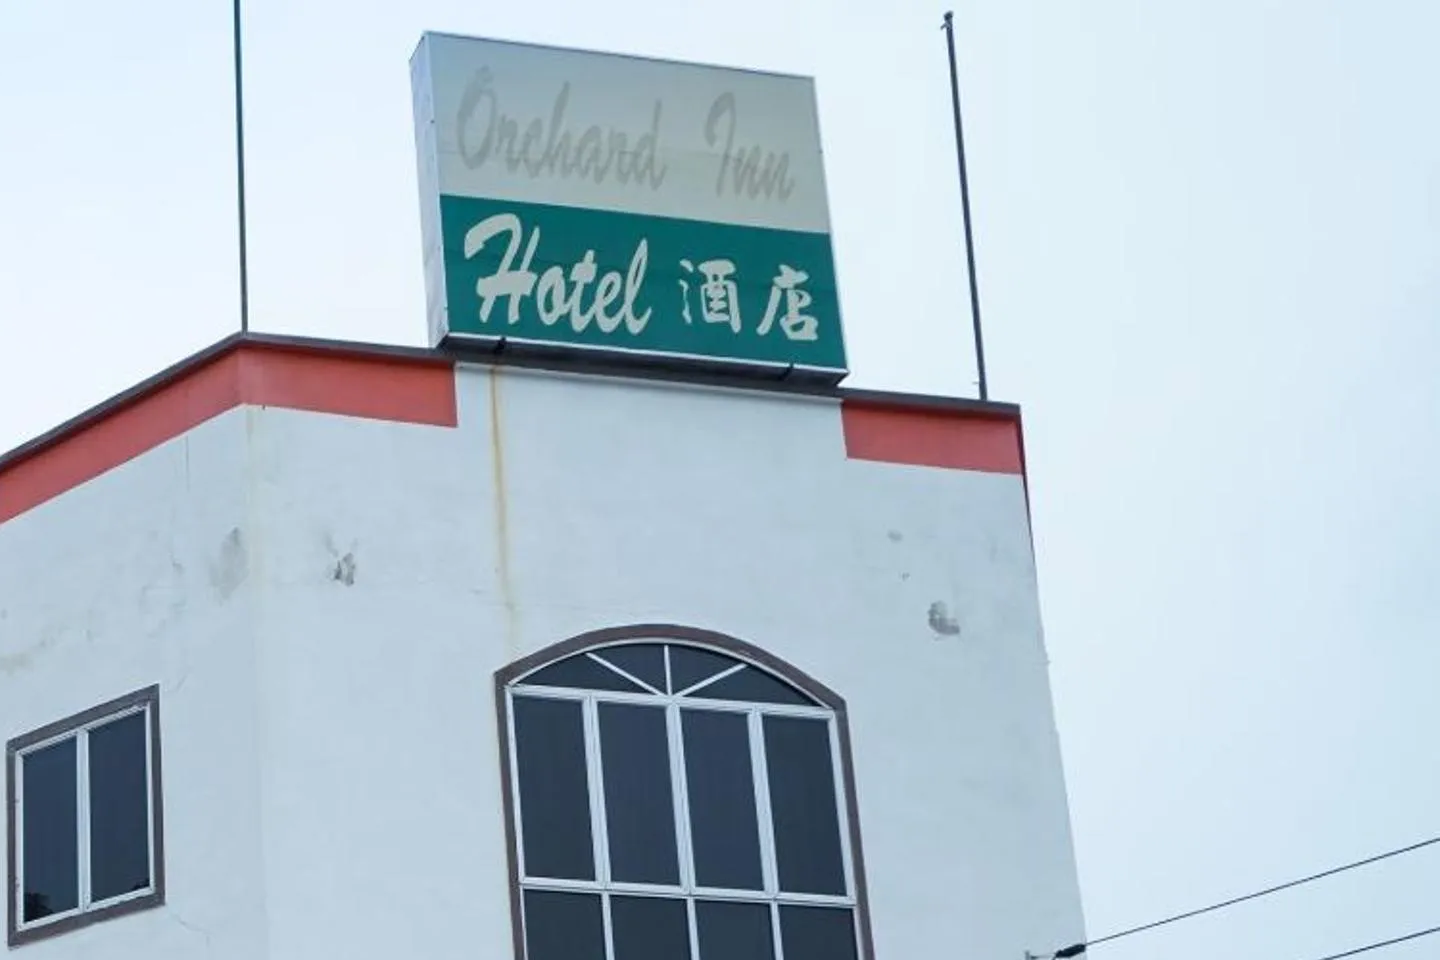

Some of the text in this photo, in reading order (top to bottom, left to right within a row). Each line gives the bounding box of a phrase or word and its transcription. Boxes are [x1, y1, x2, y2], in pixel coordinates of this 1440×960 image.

[456, 66, 795, 200] Orchard Inn
[464, 213, 652, 334] Hotel
[678, 258, 819, 341] 酒店
